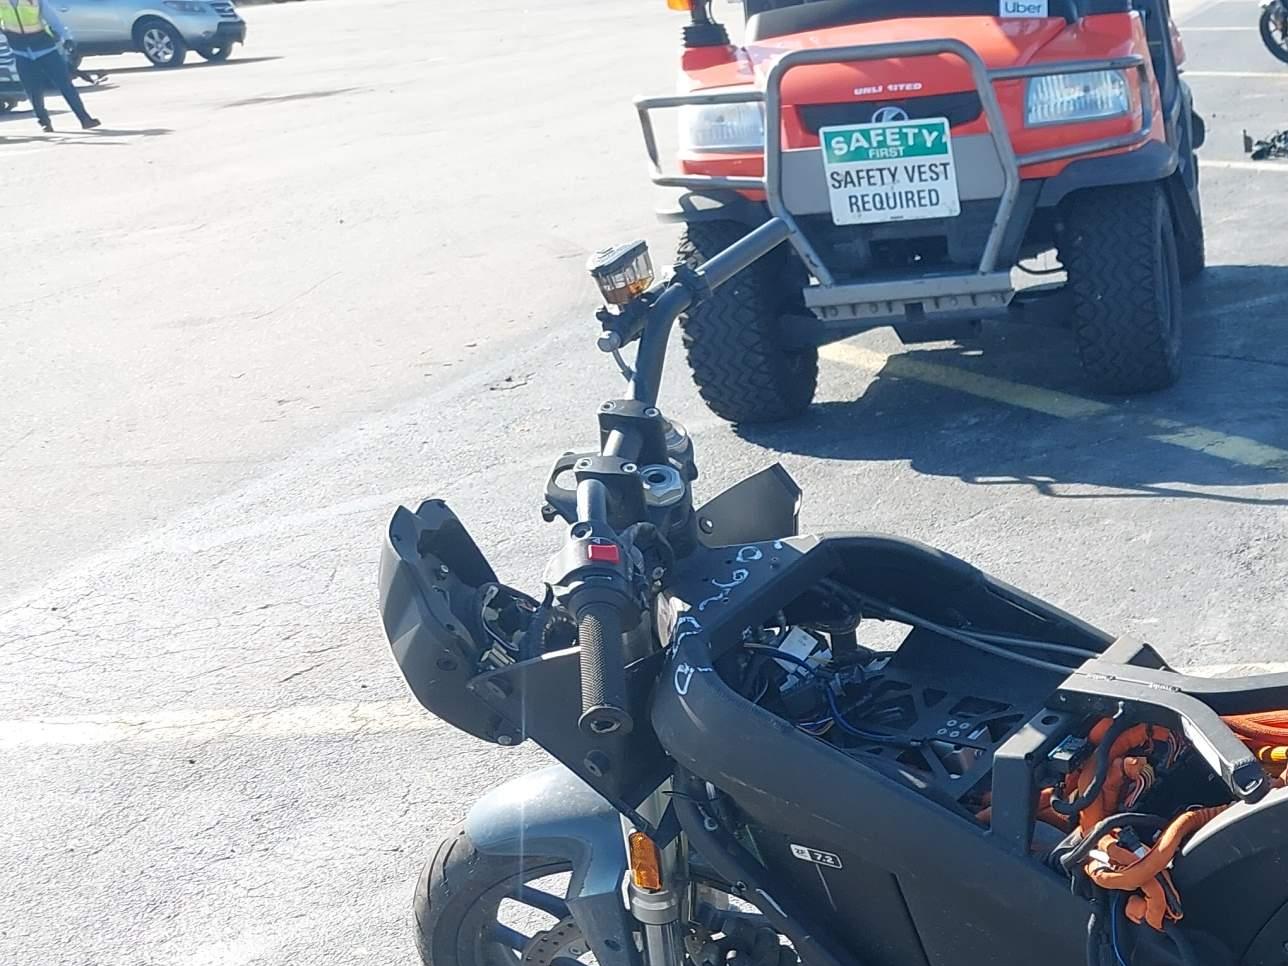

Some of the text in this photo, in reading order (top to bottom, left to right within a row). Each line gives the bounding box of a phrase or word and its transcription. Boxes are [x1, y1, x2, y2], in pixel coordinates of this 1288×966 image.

[1004, 0, 1042, 14] Uber
[831, 127, 938, 156] SAFETY
[868, 146, 905, 159] FIRST
[830, 162, 951, 190] SAFETY VEST
[848, 188, 940, 213] REQUIRED
